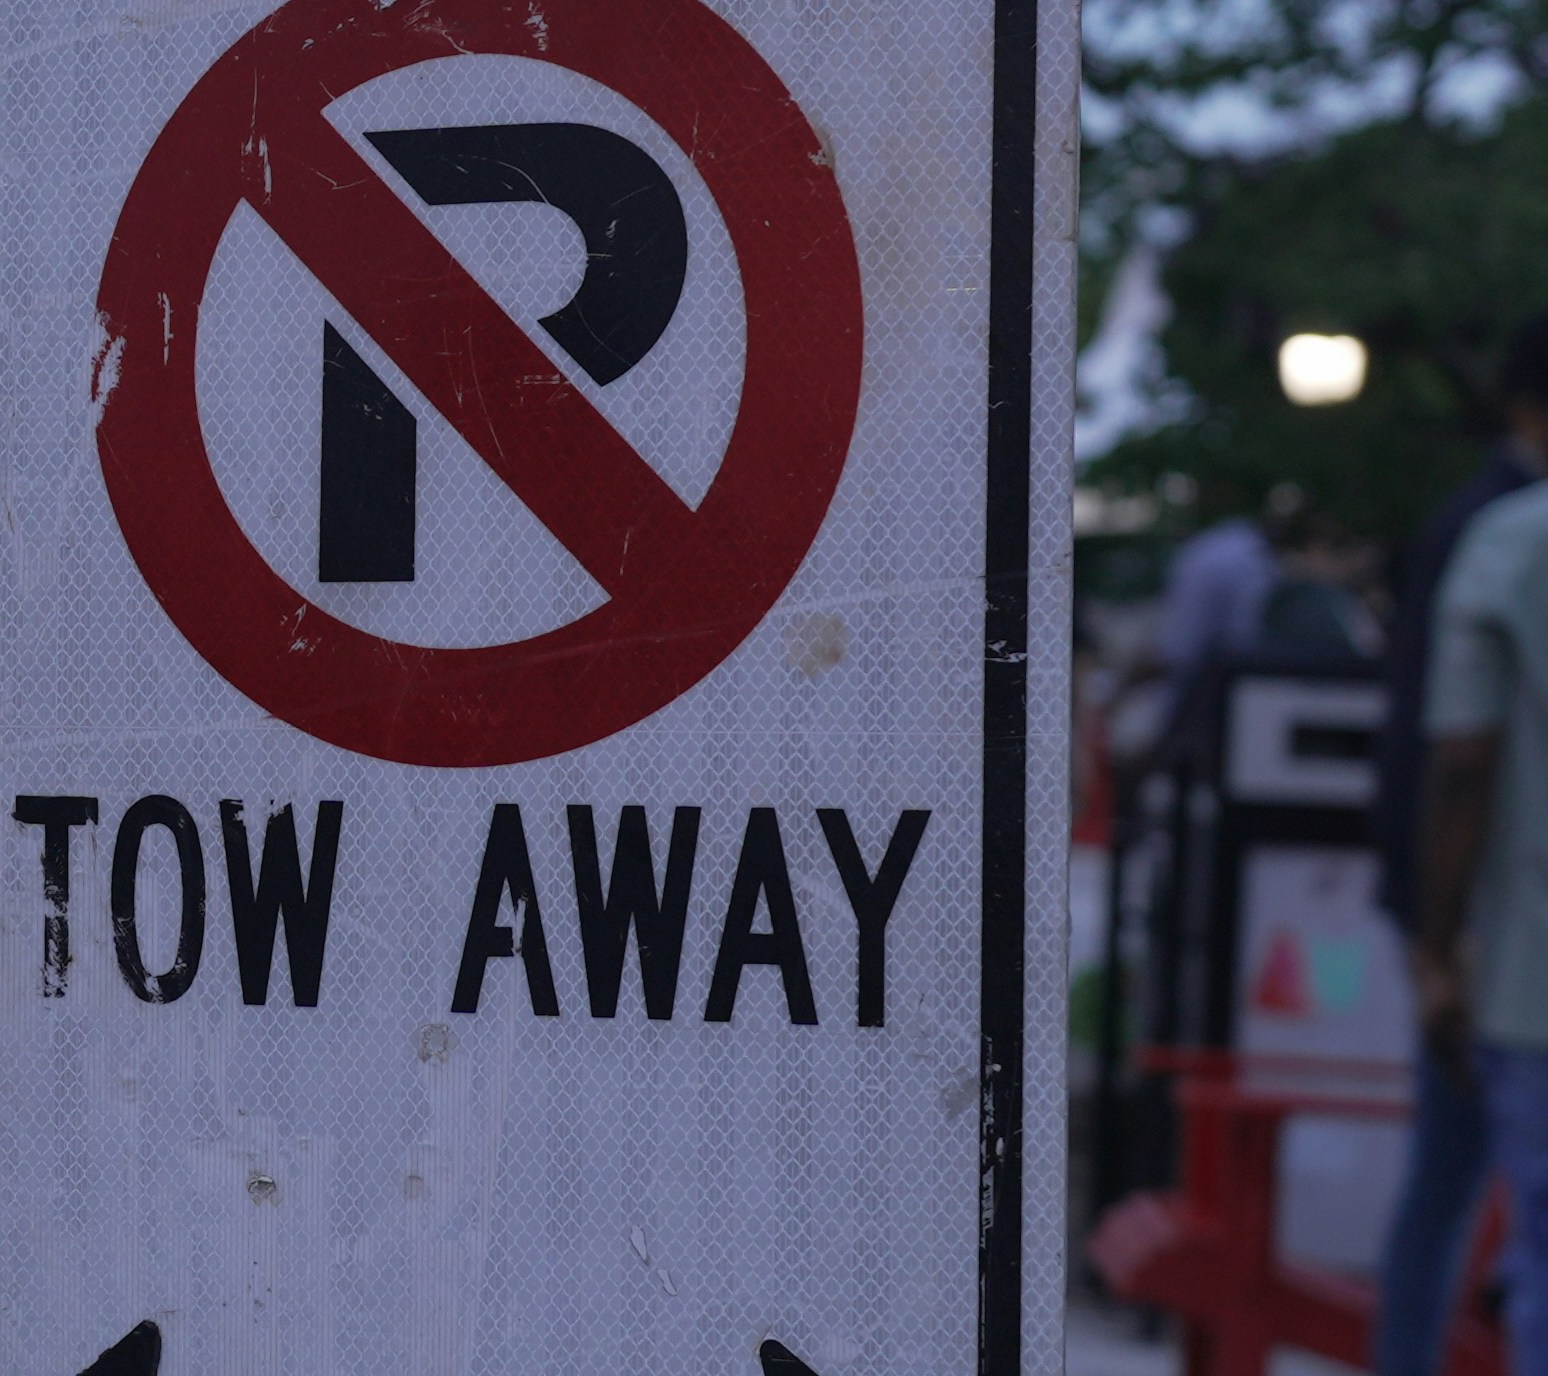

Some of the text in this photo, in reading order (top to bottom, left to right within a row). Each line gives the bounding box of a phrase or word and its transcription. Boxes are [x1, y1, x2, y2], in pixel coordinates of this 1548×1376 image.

[318, 122, 688, 582] P
[12, 794, 932, 1028] TOW AWAY
